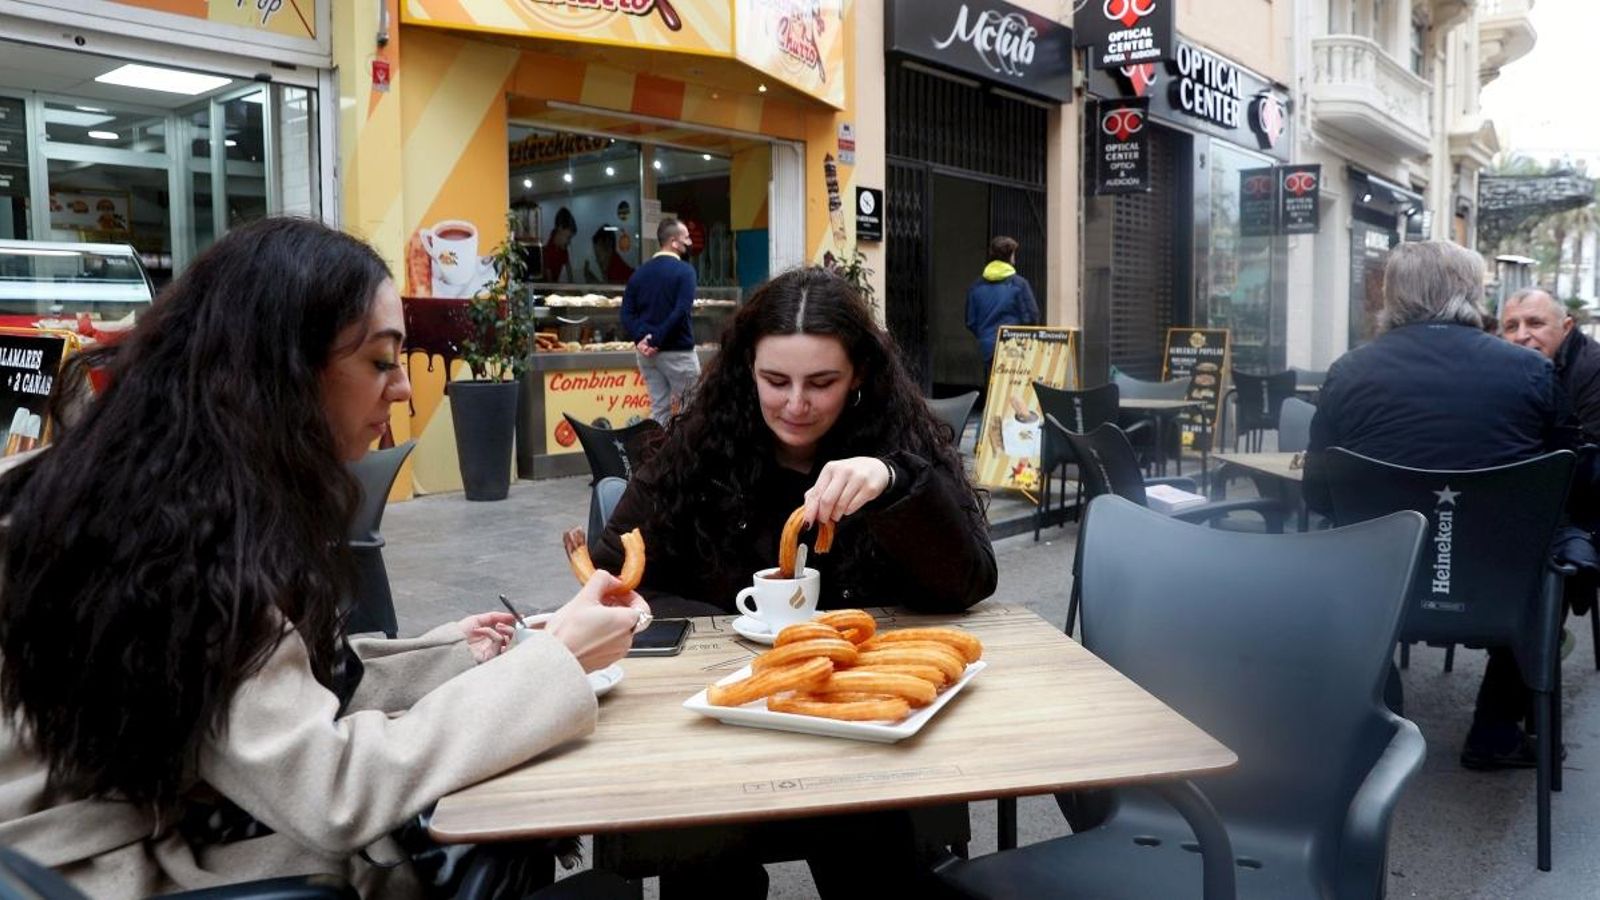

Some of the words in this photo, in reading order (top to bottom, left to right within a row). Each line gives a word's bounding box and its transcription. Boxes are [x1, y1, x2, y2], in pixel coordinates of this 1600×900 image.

[1108, 27, 1153, 42] OPTICAL
[1108, 38, 1153, 53] CENTER
[1177, 43, 1242, 100] OPTICAL
[1180, 77, 1240, 128] CENTER
[1105, 142, 1139, 152] OPTICAL
[1105, 151, 1139, 161] CENTER
[13, 372, 21, 392] 2
[550, 371, 627, 391] Combina
[622, 394, 653, 409] PAG
[1432, 511, 1453, 594] Heineken
